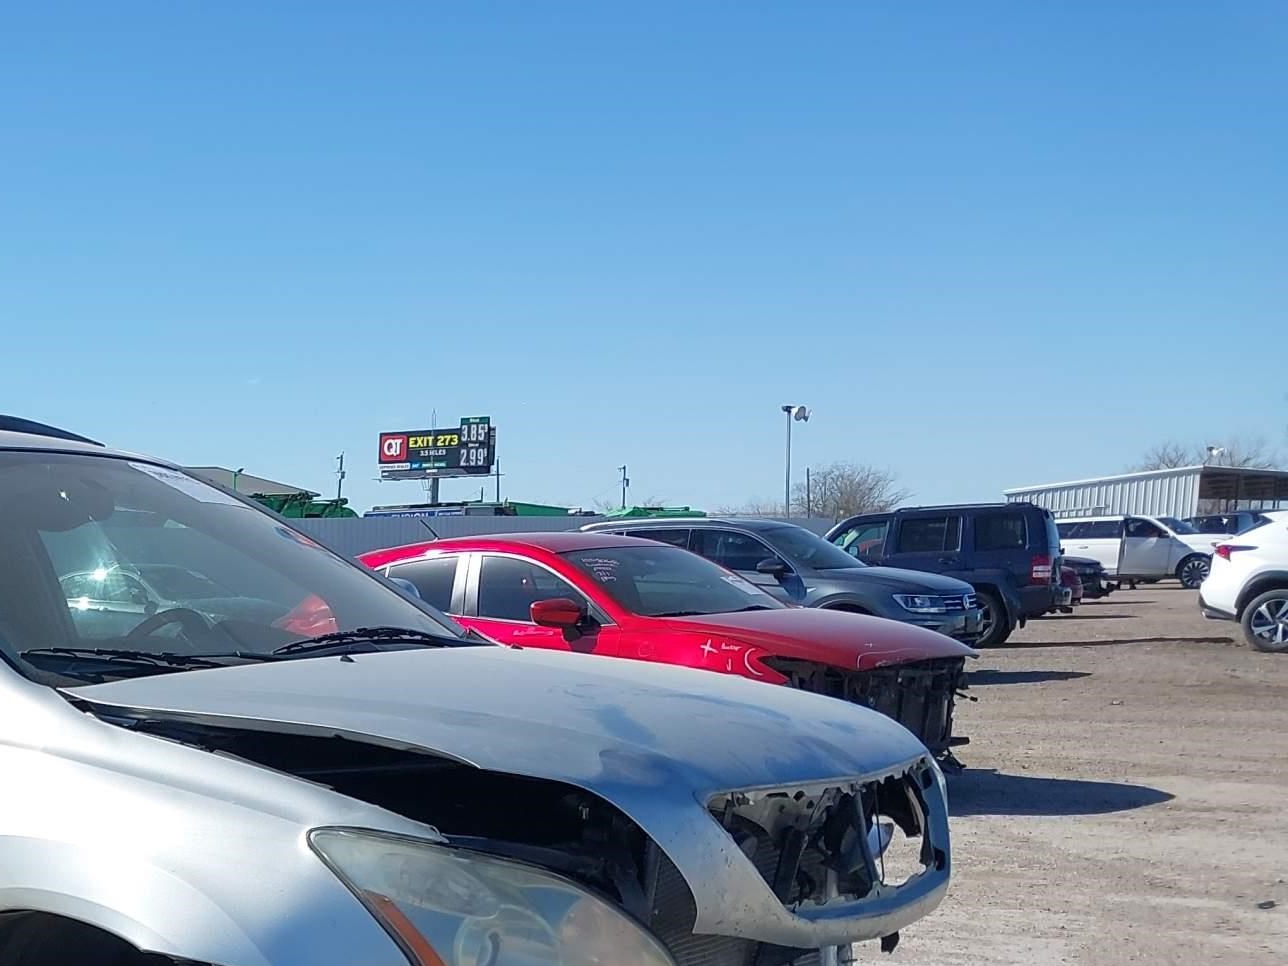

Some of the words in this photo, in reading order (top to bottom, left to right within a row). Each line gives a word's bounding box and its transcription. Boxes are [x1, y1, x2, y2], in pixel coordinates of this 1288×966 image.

[384, 439, 403, 457] QT
[409, 437, 434, 447] EXIT
[437, 434, 458, 446] 273
